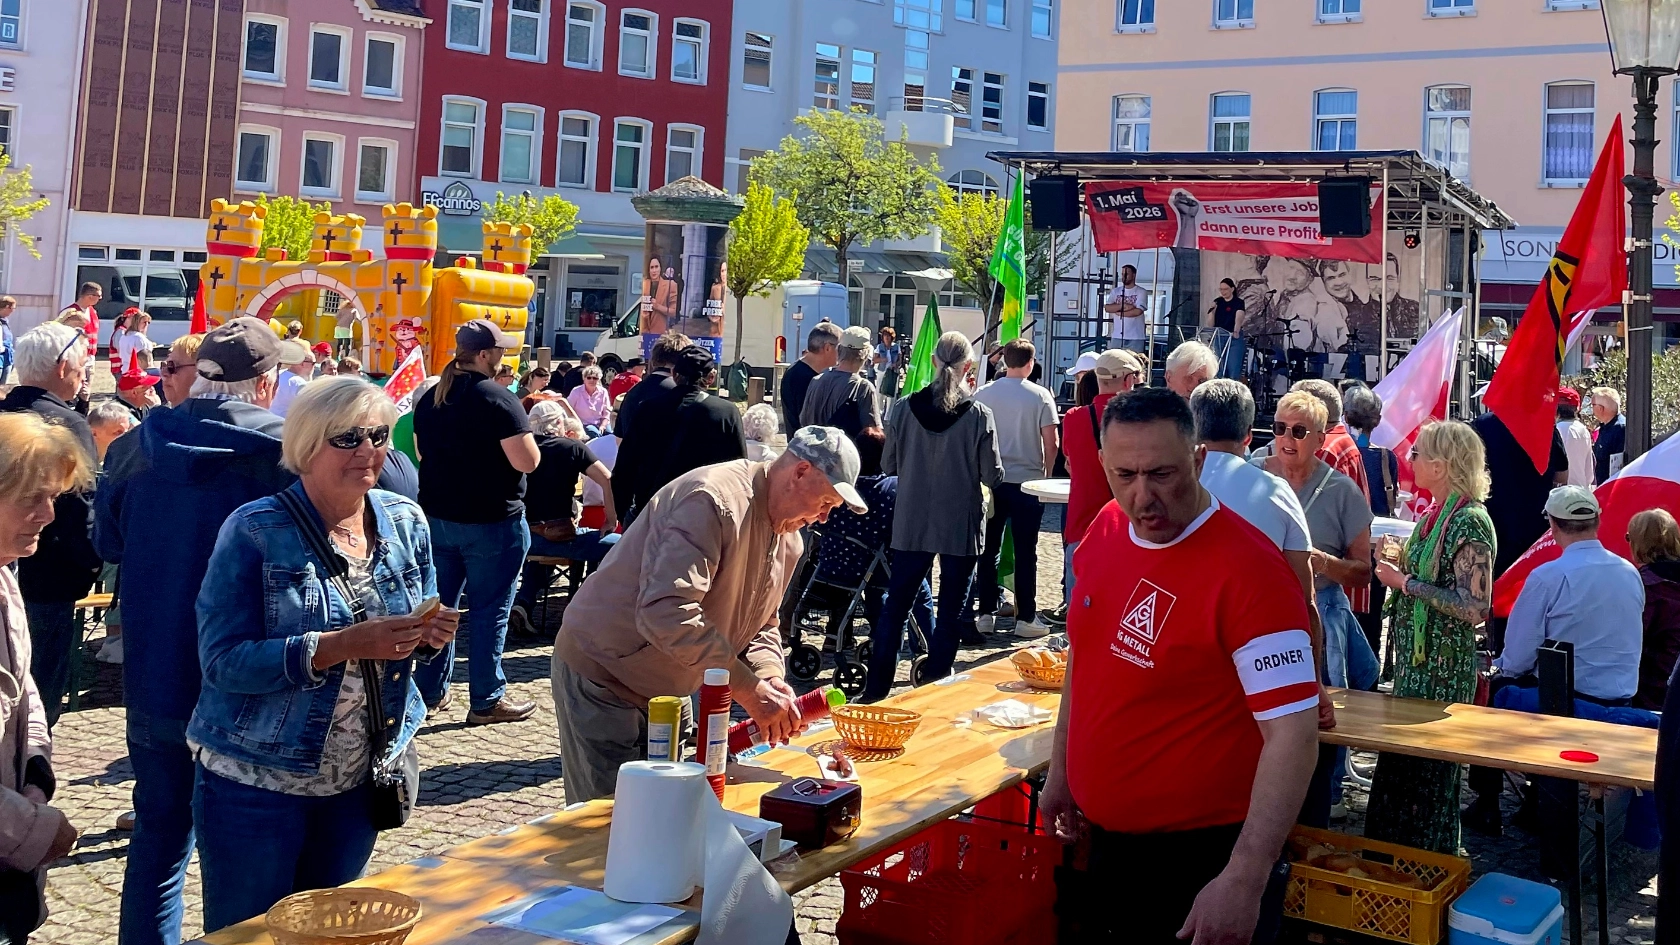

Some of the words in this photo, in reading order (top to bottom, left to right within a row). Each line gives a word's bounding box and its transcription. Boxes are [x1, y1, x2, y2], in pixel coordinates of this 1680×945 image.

[1096, 196, 1108, 208] 1.
[1109, 191, 1138, 208] Mai
[1203, 203, 1232, 215] Erst
[1234, 203, 1287, 214] unsere
[1290, 201, 1318, 212] Job
[1125, 206, 1162, 219] 2026
[1200, 220, 1238, 234] dann
[1241, 224, 1275, 236] eure
[1278, 225, 1323, 241] Profit
[1654, 244, 1680, 260] DI
[1123, 634, 1150, 657] METALL
[1120, 648, 1155, 669] Gewerkschaft
[1254, 649, 1304, 672] ORDNER
